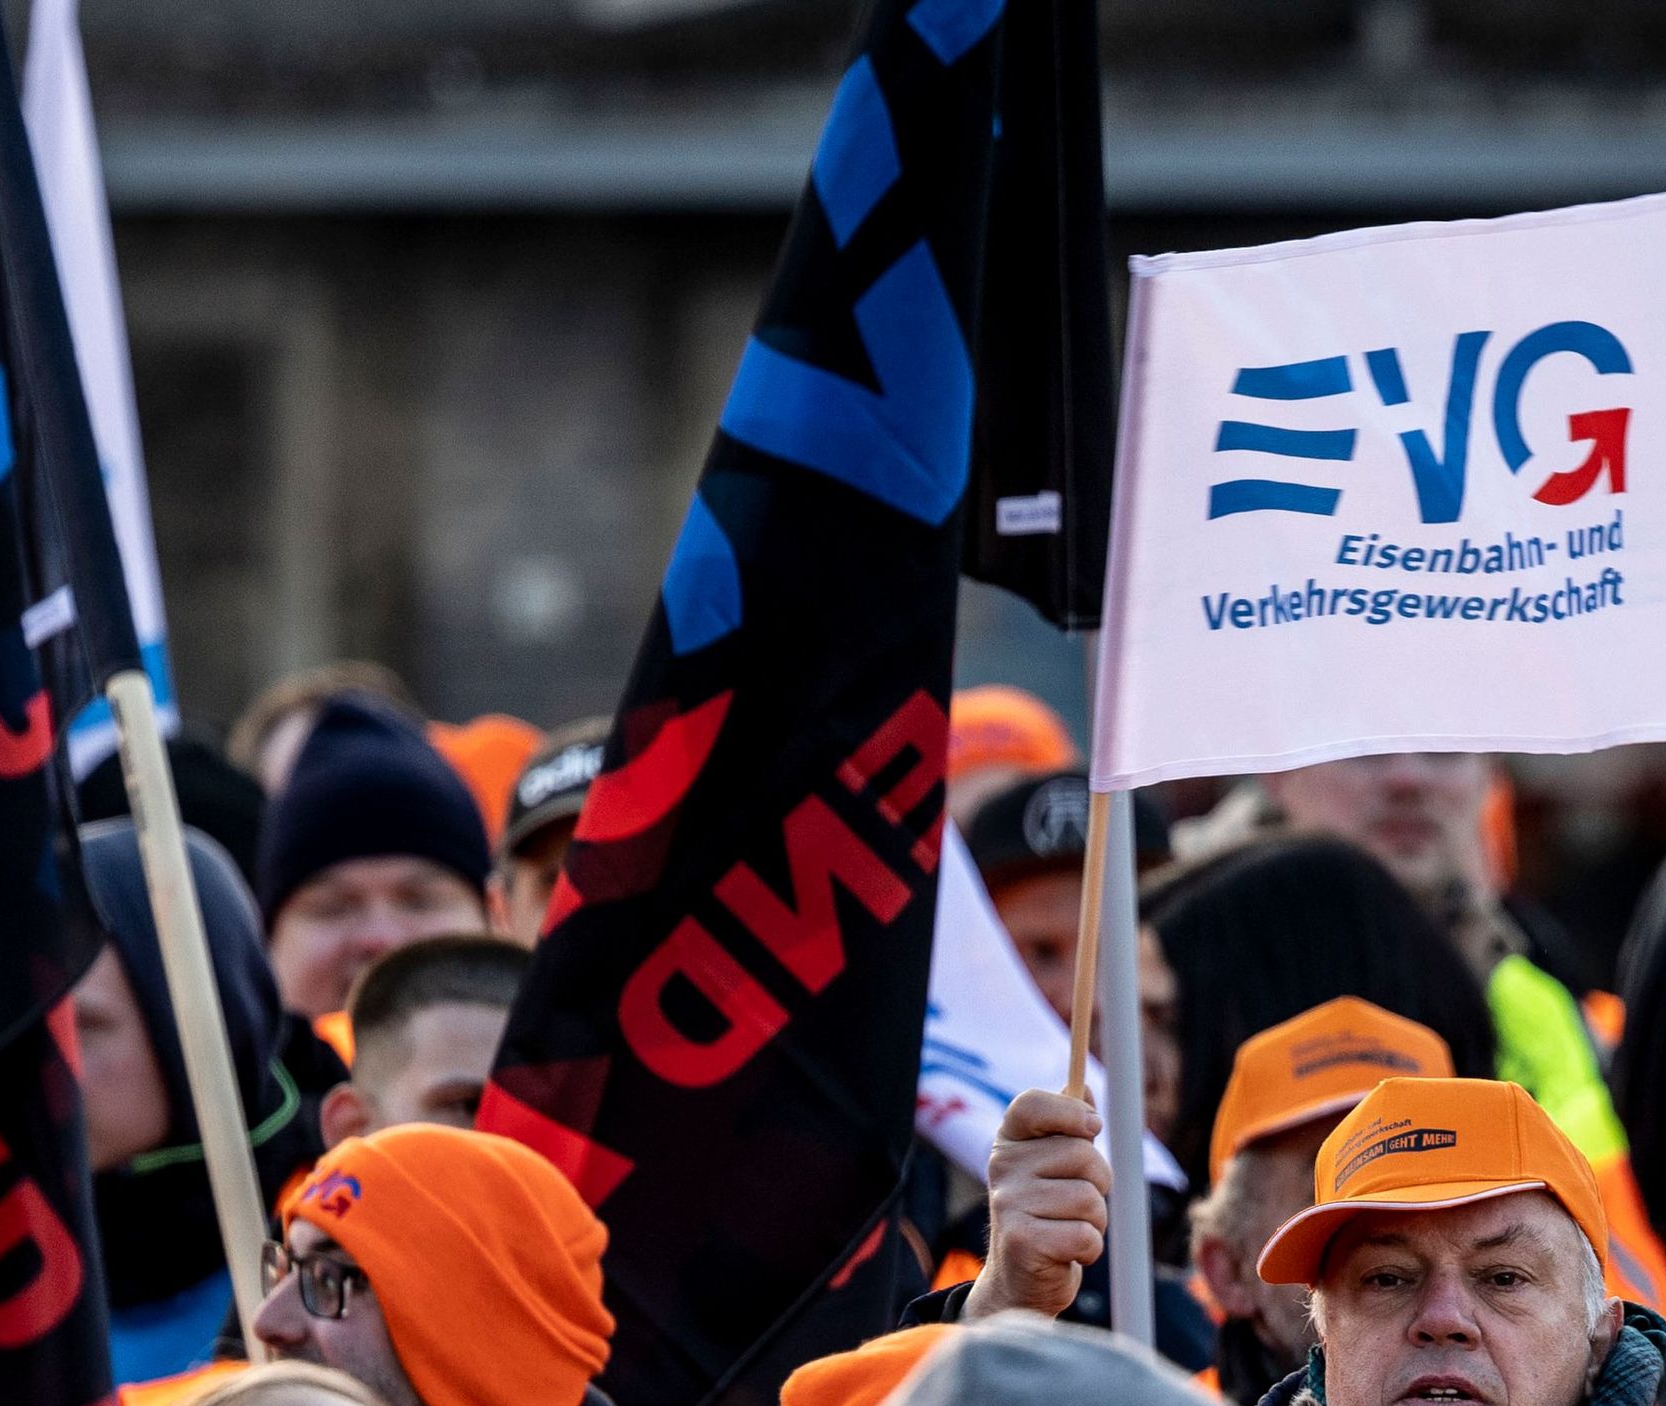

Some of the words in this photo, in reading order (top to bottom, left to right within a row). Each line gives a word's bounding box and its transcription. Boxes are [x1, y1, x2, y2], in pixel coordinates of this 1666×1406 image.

[1207, 321, 1635, 524] EVG
[1336, 532, 1558, 575] Eisenbahn-
[1568, 509, 1624, 559] und
[1202, 567, 1624, 631] Verkehrsgewerkschaft
[1389, 1134, 1418, 1151] GEHT
